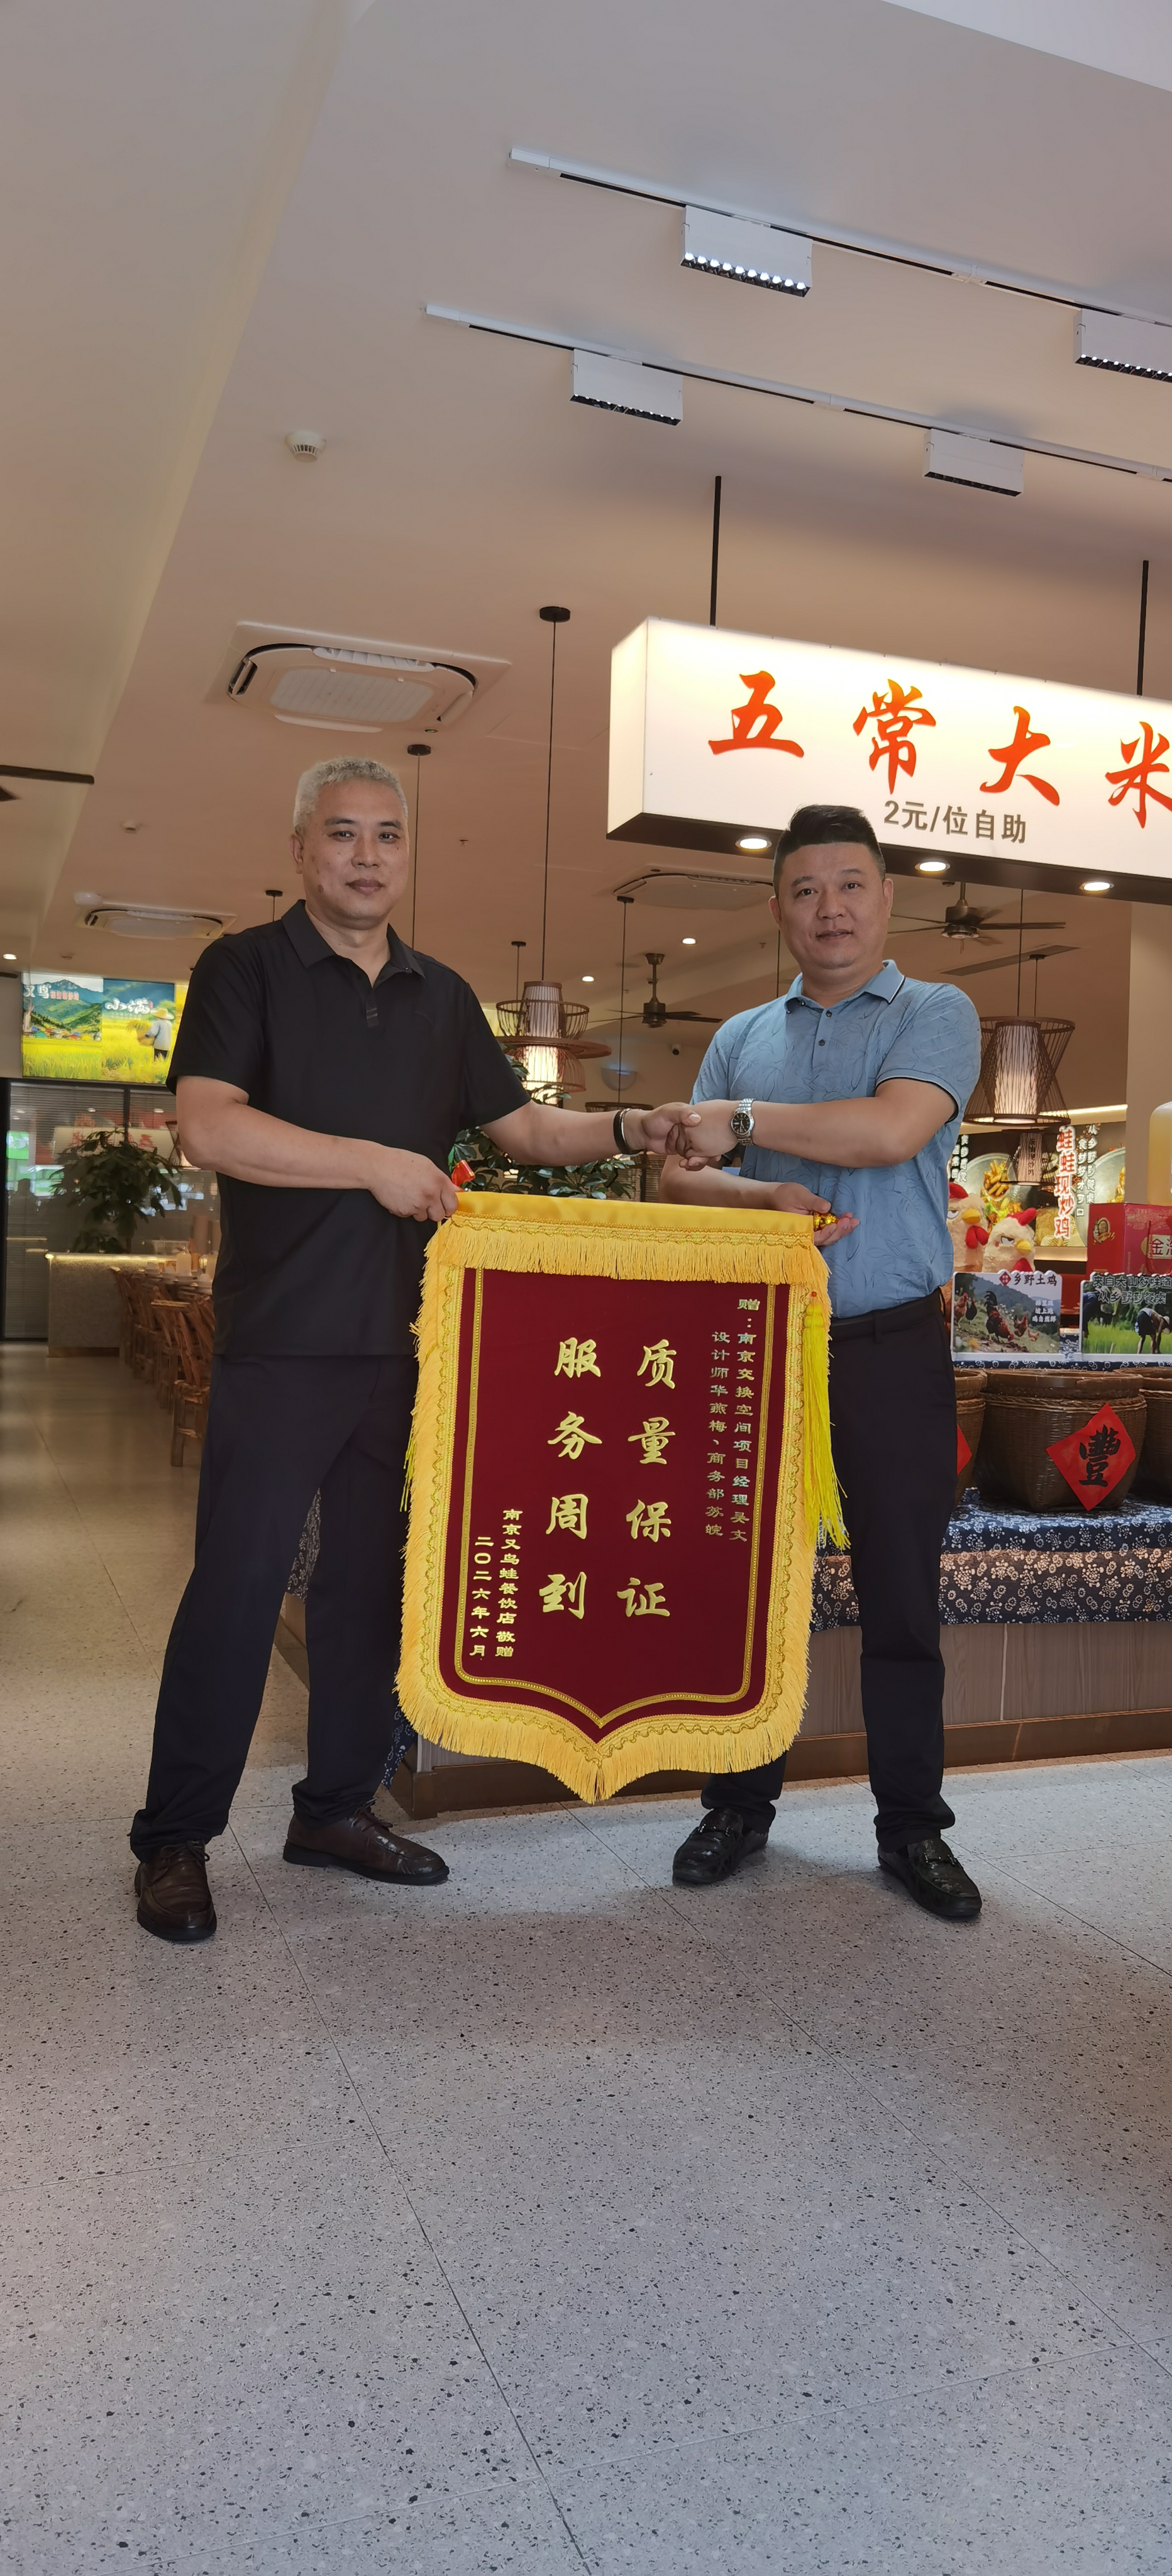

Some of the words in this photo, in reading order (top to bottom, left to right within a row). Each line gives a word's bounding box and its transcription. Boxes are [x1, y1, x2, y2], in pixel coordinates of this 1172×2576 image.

[708, 670, 1172, 829] 五常大米
[883, 800, 1027, 844] 2元/位自助
[1054, 1126, 1076, 1239] 蛙蛙现炒鸡
[1076, 1138, 1087, 1217] 食材好才可口
[1086, 1124, 1098, 1204] 从乡野到餐桌
[1014, 1272, 1058, 1287] 乡野土鸡
[1093, 1274, 1172, 1290] 来自大山好味道
[1096, 1287, 1167, 1305] 从乡野到餐桌
[538, 1336, 602, 1619] 服务周到
[616, 1339, 677, 1617] 质量保证
[496, 1509, 523, 1624] 南京又鸟蛙餐饮店
[495, 1631, 516, 1657] 敬赠
